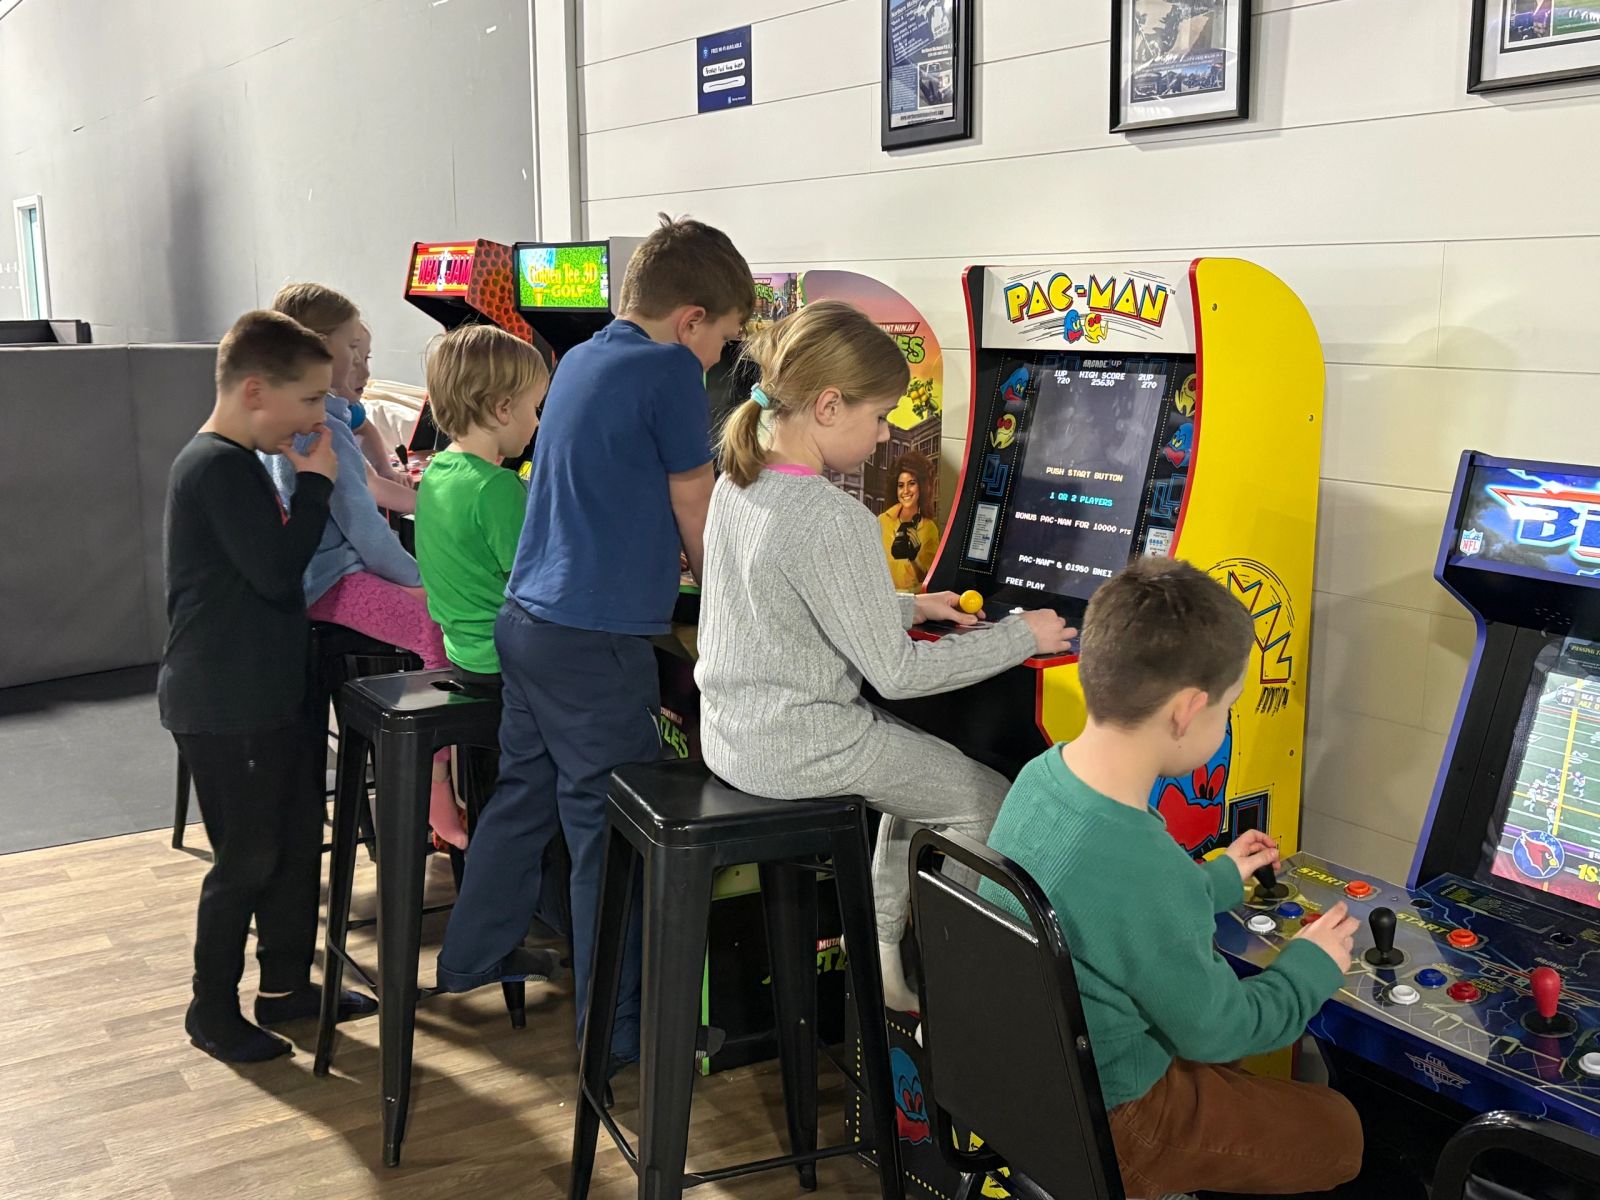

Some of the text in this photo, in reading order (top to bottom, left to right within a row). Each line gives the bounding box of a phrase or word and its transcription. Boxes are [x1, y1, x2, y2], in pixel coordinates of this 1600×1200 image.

[418, 255, 475, 285] NBA JAM
[563, 263, 580, 283] Tee
[582, 262, 598, 284] 3D
[1004, 272, 1169, 328] PAC-MAN
[1054, 370, 1068, 378] 1UP
[1057, 377, 1071, 385] 720
[1079, 371, 1126, 380] HIGH SCORE
[1138, 373, 1154, 382] 2UP
[1091, 379, 1115, 387] 25630
[1142, 381, 1158, 389] 270
[1046, 467, 1123, 483] PUSH START BUTTON
[1049, 492, 1113, 507] 1 OR 2 PLAYERS
[1015, 512, 1132, 535] BONUS PAC-MAN FOR 10000 PTS
[1462, 540, 1478, 551] NFL
[1005, 576, 1045, 591] FREE PLAY
[1297, 867, 1348, 887] START
[1578, 864, 1599, 882] 1S
[1397, 912, 1450, 934] START
[818, 938, 841, 951] MUTA
